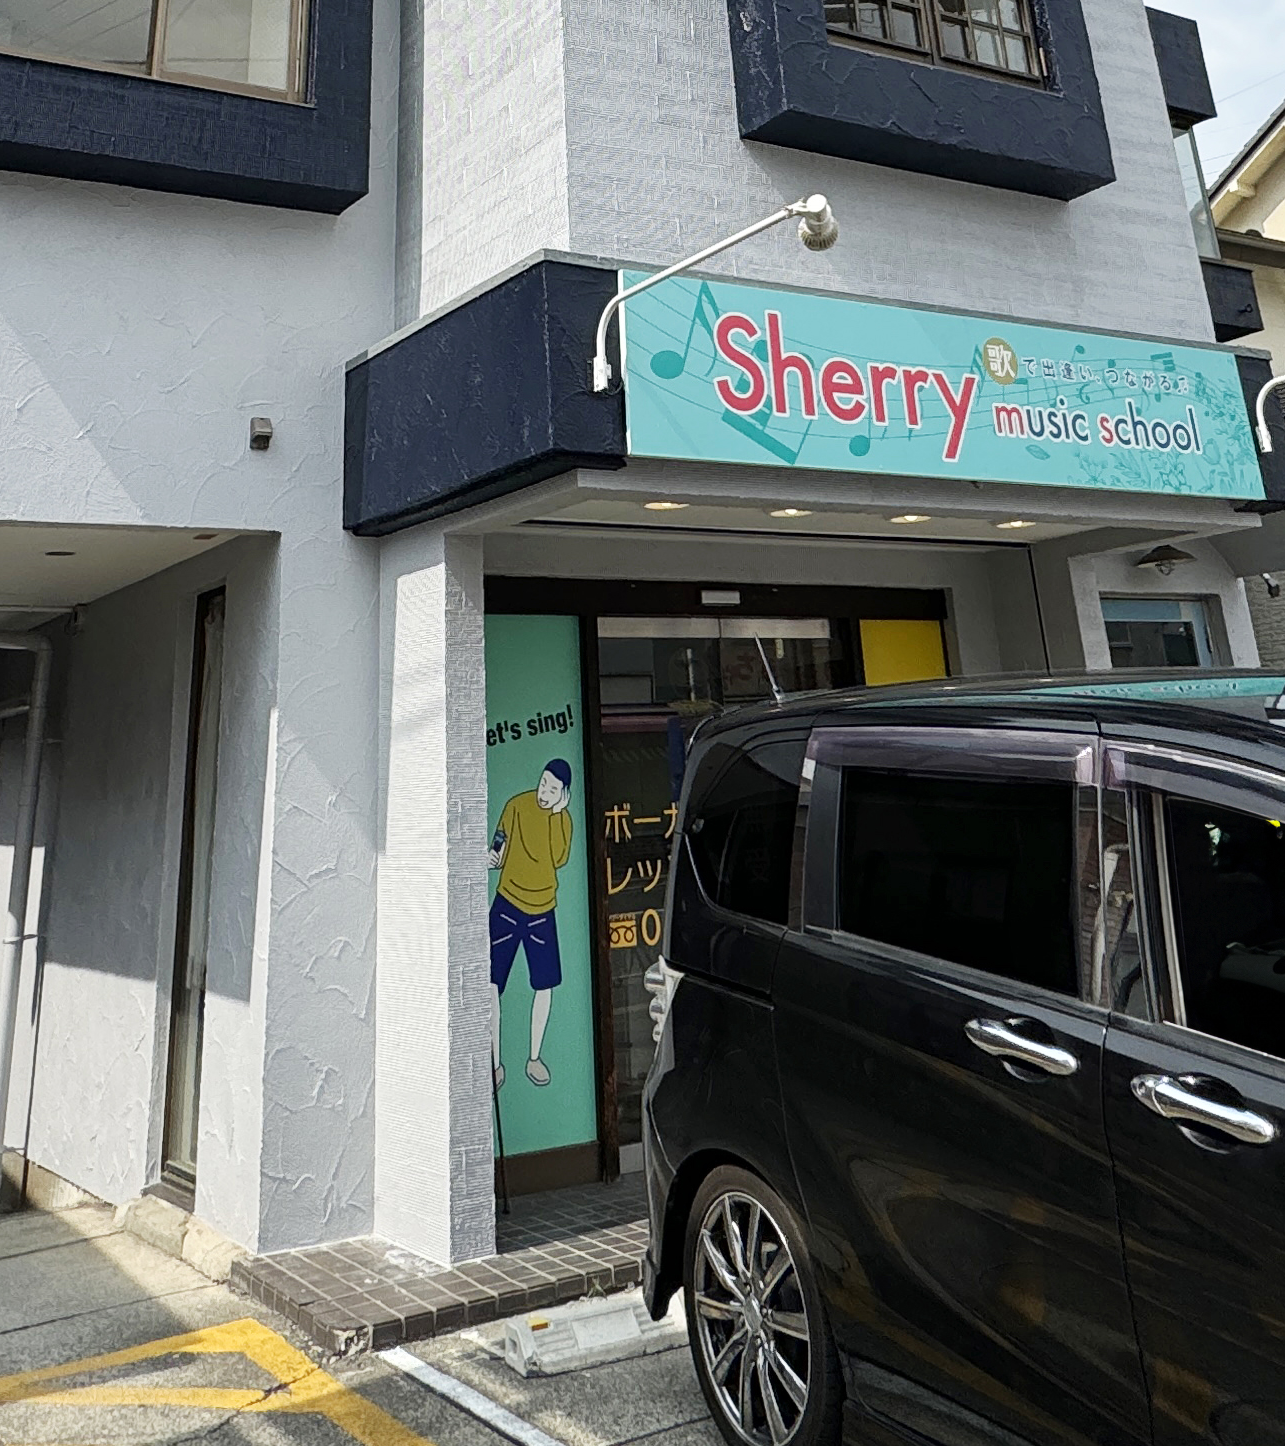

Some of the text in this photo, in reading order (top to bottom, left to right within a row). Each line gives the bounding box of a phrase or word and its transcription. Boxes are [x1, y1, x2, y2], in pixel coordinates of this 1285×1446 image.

[714, 310, 978, 461] Sherry
[994, 397, 1202, 452] music school
[486, 704, 575, 746] et's sing!
